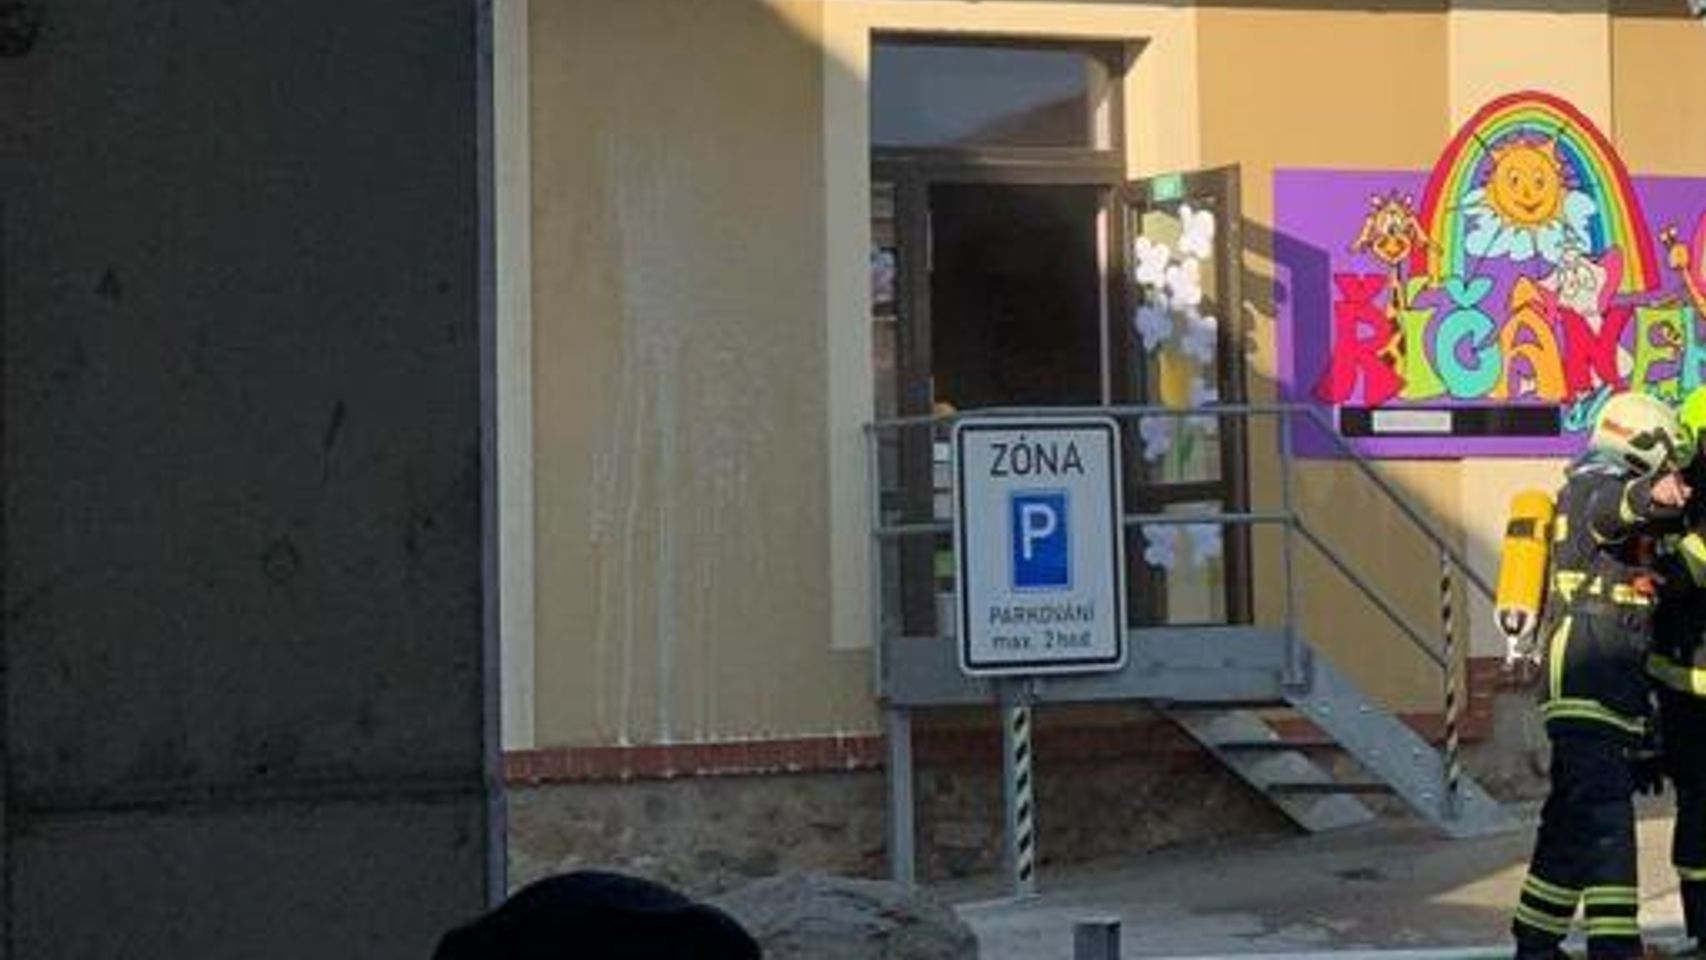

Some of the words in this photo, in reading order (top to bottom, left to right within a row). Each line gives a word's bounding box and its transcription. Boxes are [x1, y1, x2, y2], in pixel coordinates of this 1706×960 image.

[990, 436, 1085, 477] ZÓNA
[1021, 503, 1056, 560] P
[989, 601, 1095, 624] PARKOVÁNÍ
